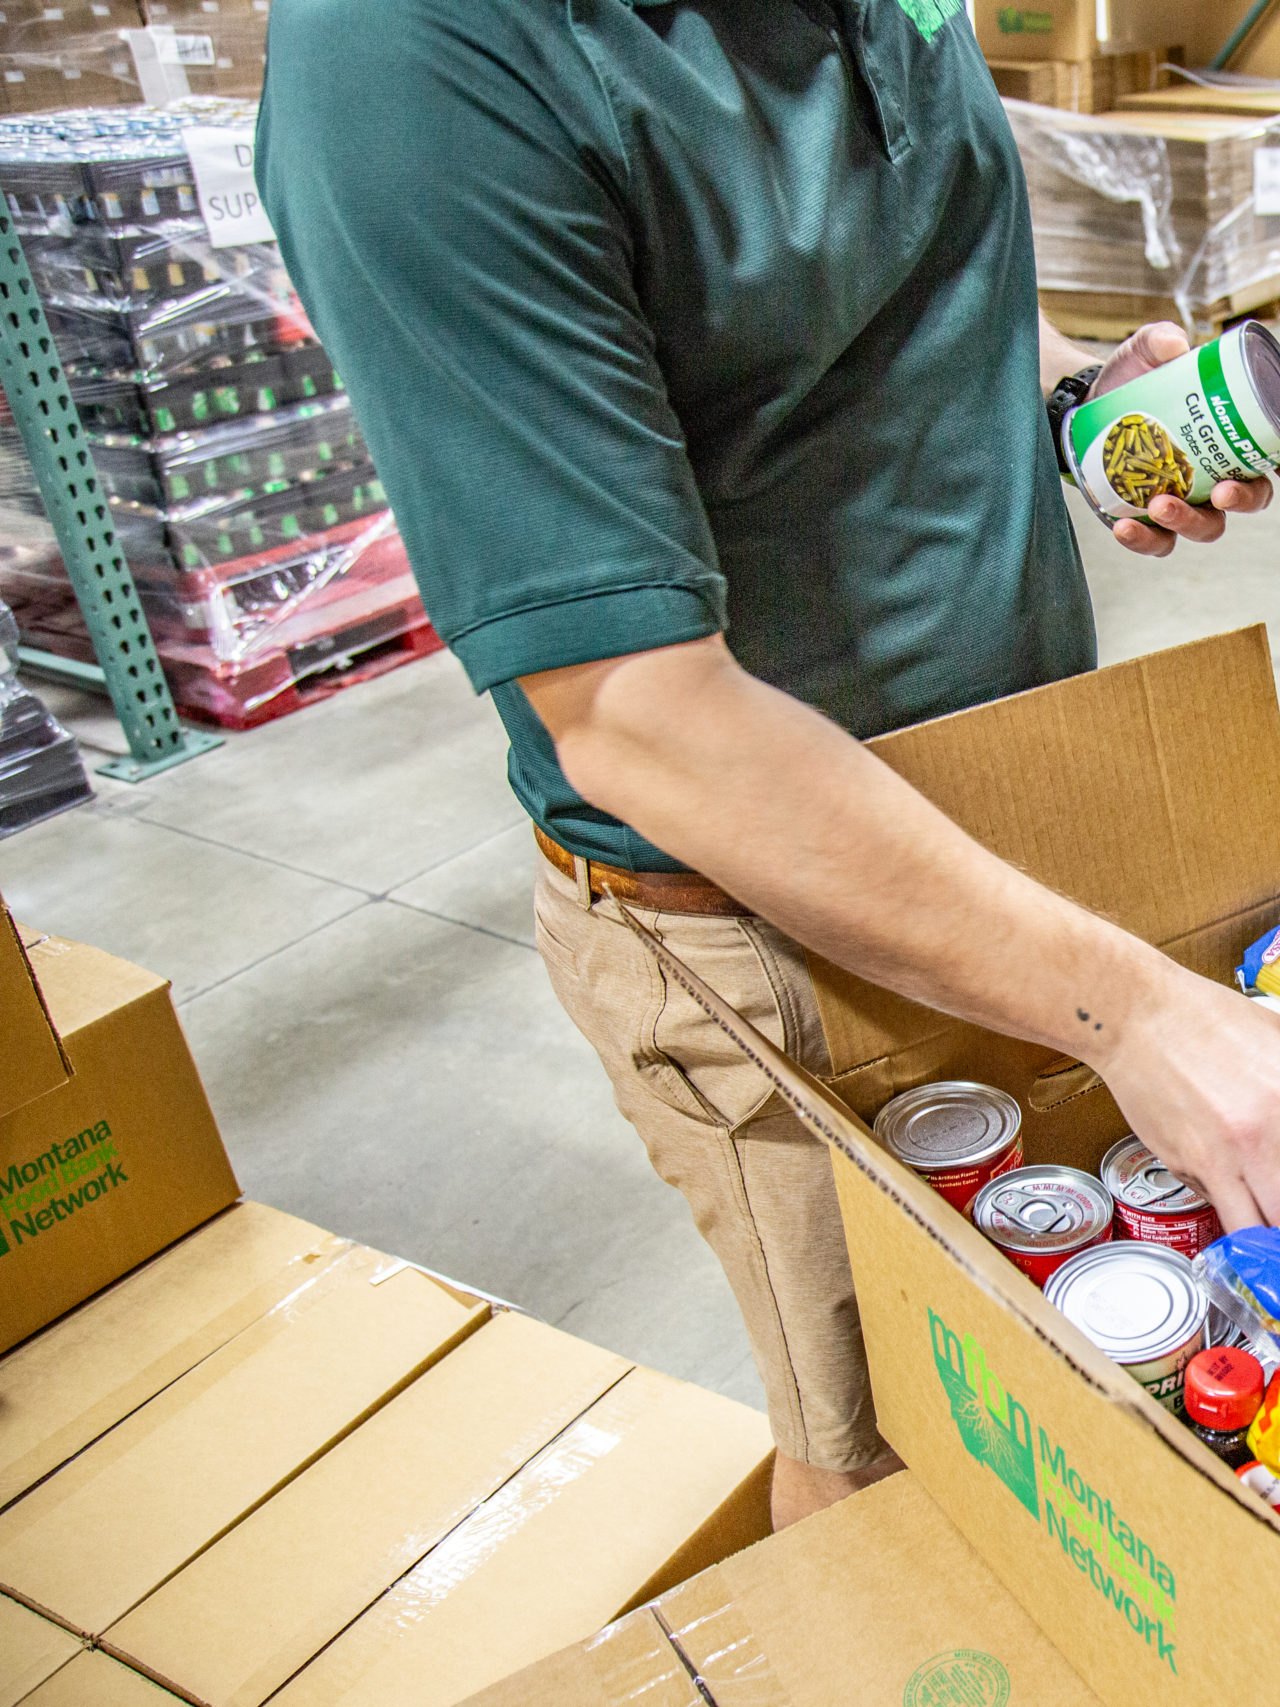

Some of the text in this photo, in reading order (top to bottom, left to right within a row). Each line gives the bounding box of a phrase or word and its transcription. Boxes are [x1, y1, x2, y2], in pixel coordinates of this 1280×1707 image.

[234, 144, 254, 168] D
[208, 192, 258, 221] SUP
[1180, 423, 1224, 484] Ejotes Corta
[1185, 392, 1205, 423] Cut
[1198, 424, 1231, 469] Green
[1210, 395, 1277, 474] NORTH PRID
[0, 1119, 112, 1199] Montana
[0, 1140, 119, 1220] Food Bank
[9, 1161, 129, 1245] Network
[1127, 1210, 1141, 1219] WITH
[1141, 1214, 1156, 1222] RICE
[1144, 1370, 1184, 1396] PRI
[1038, 1425, 1177, 1602] Montana
[1041, 1462, 1177, 1635] Food Bank
[1045, 1498, 1178, 1675] Network
